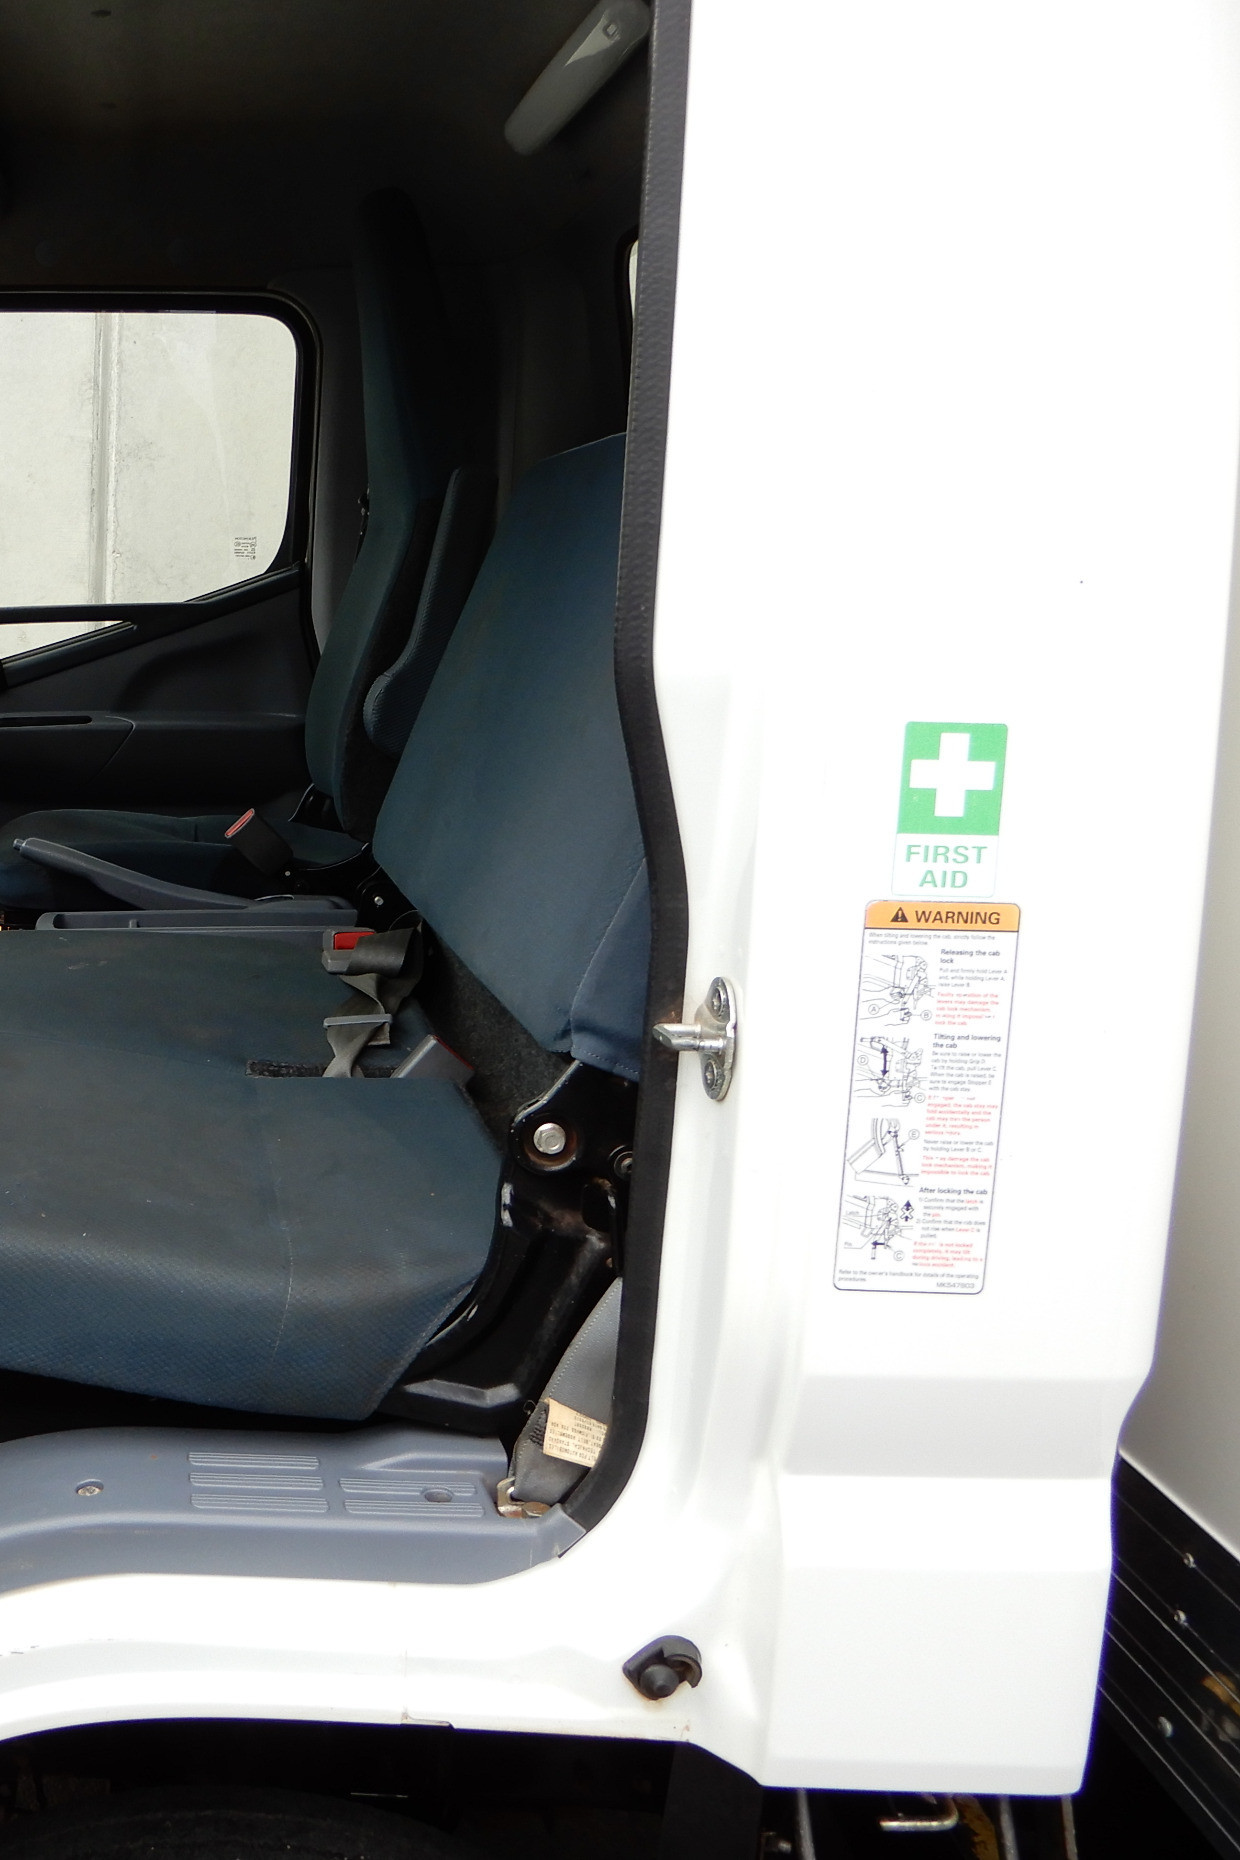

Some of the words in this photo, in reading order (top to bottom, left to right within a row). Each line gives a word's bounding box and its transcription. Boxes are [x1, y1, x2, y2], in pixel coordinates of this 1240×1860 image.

[906, 844, 987, 864] FIRST
[919, 870, 968, 888] AID
[915, 910, 1001, 924] WARNING
[941, 949, 973, 957] Releasing
[934, 1033, 955, 1041] Tilting
